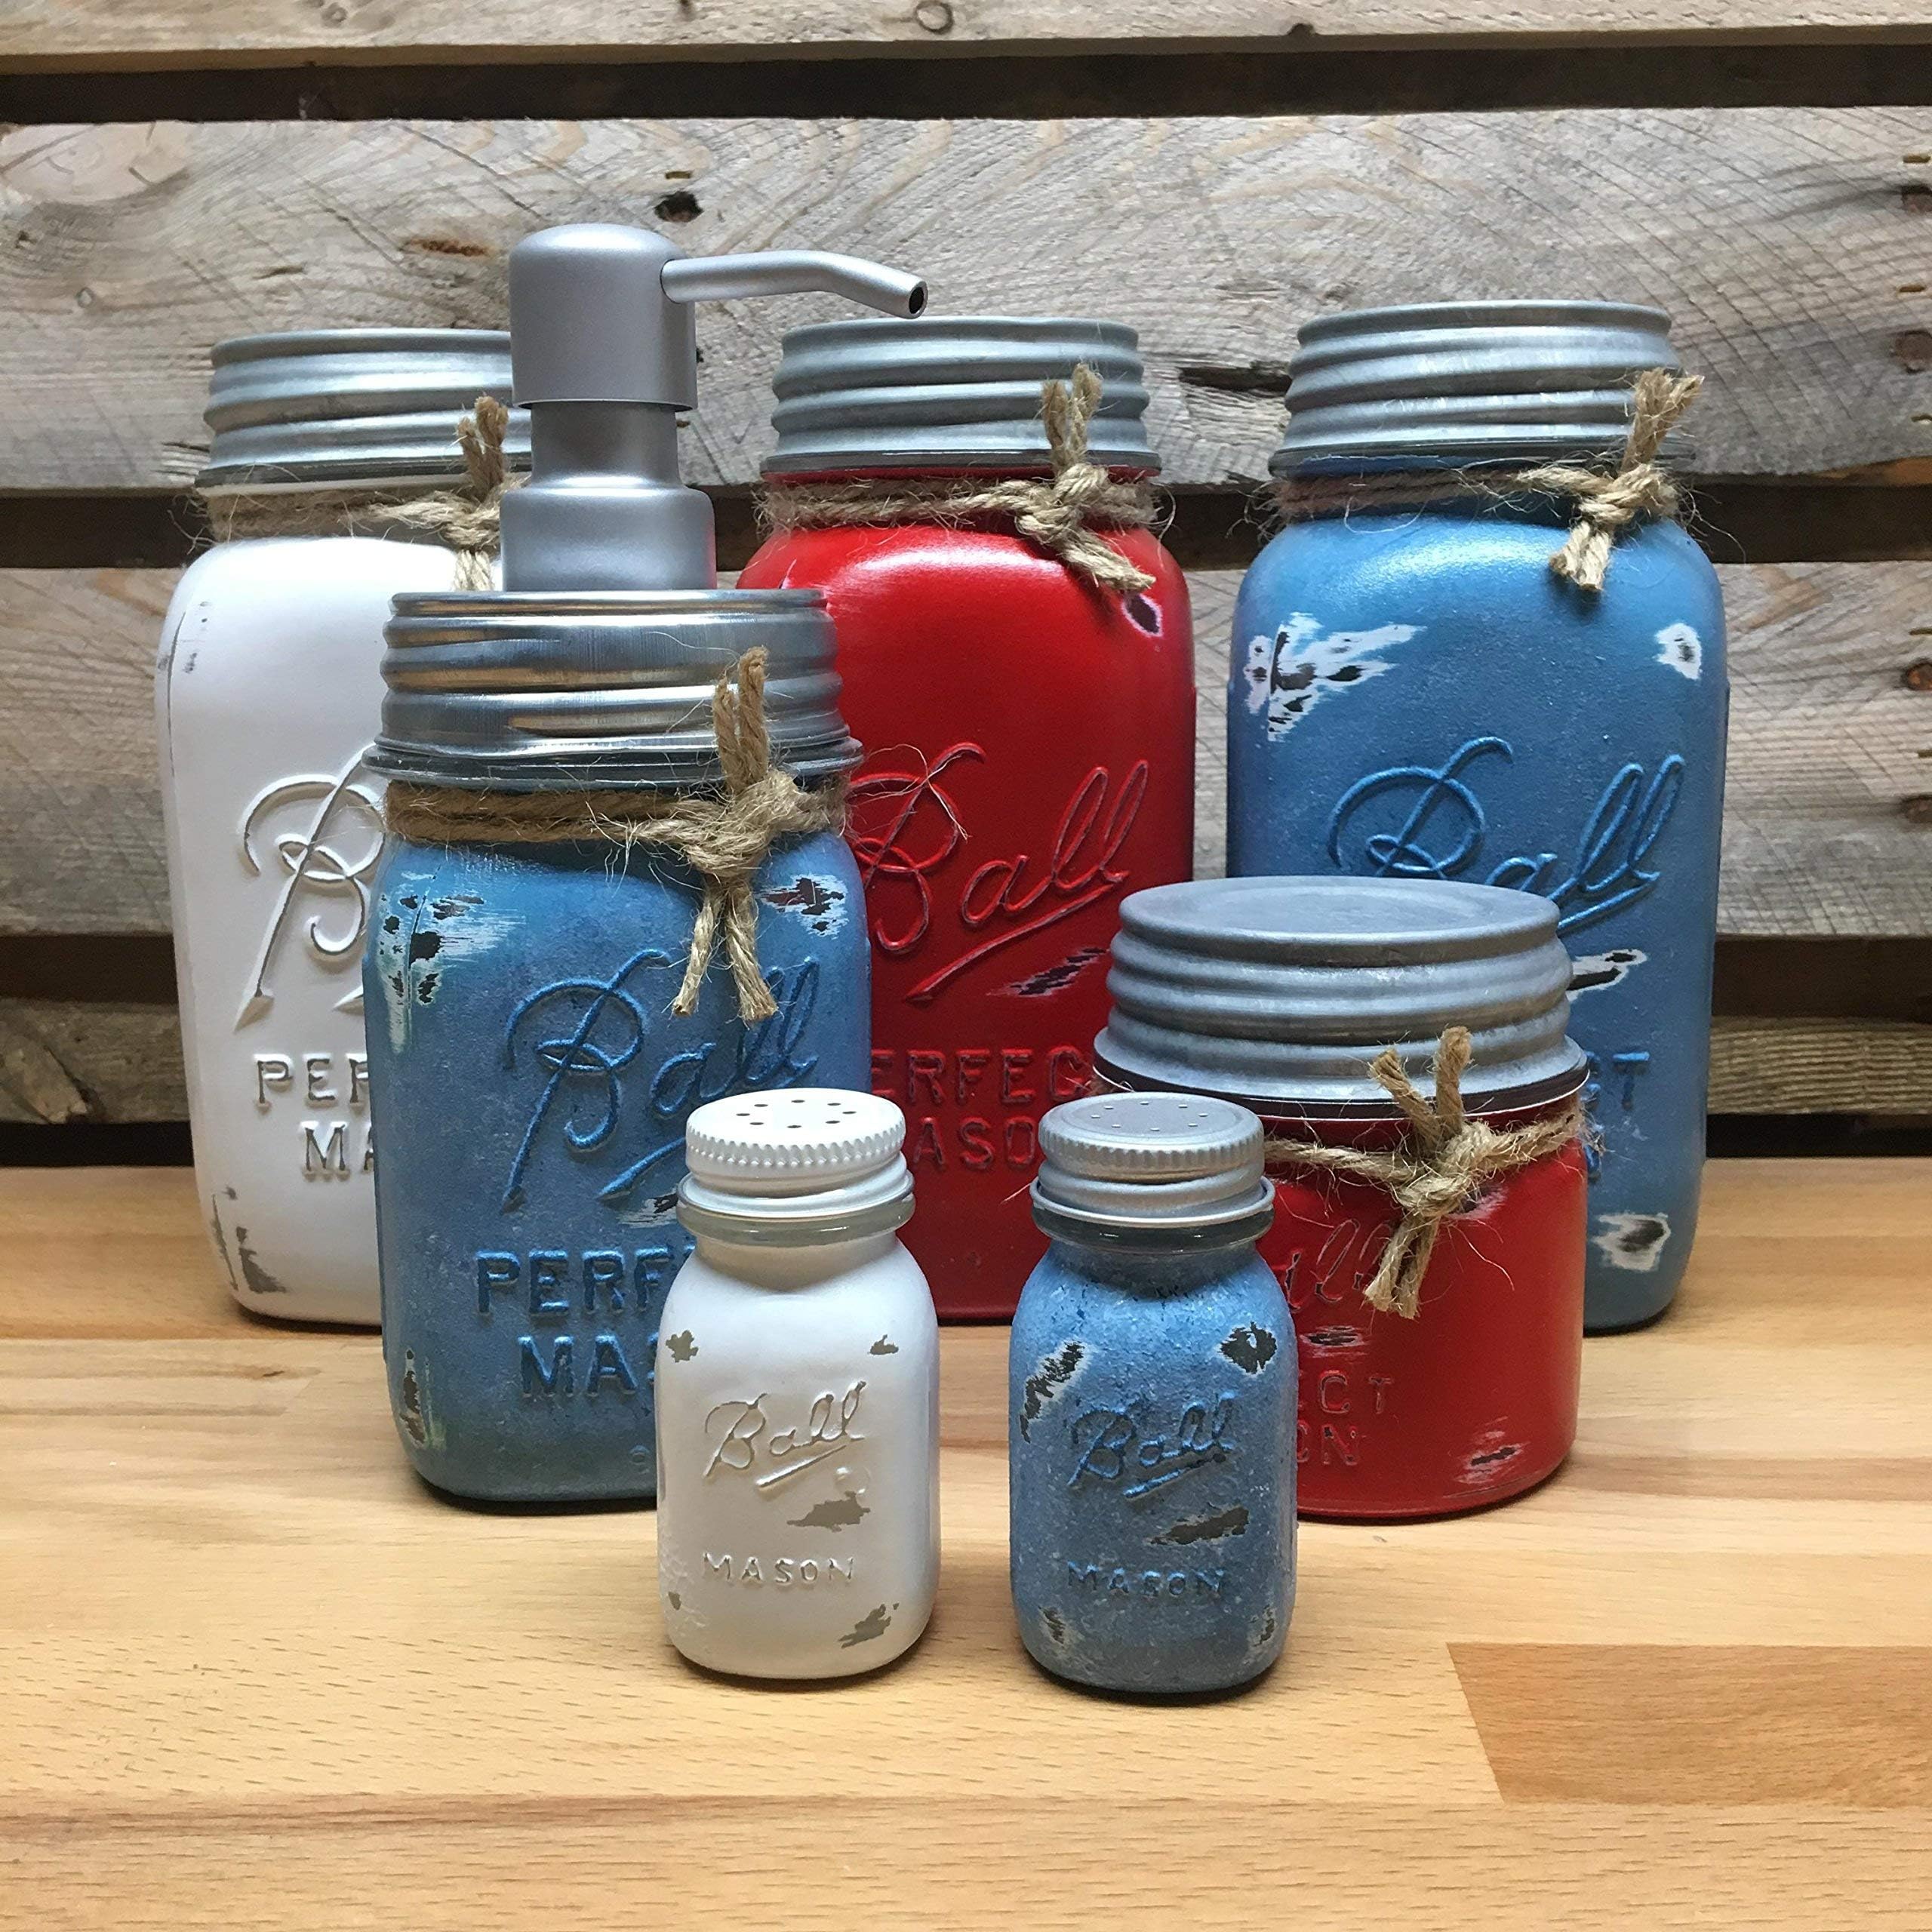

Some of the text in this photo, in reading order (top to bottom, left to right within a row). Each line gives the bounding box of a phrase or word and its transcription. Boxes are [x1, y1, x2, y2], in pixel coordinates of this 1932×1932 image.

[849, 743, 1149, 952] Ball
[501, 948, 820, 1211] Ball
[872, 1044, 1087, 1102] ERFEC
[912, 1116, 1035, 1167] ASO
[475, 1246, 696, 1316] PERF
[702, 1380, 868, 1480] Ball
[1066, 1390, 1241, 1487] Ball
[701, 1551, 855, 1586] MASON
[1066, 1560, 1226, 1598] MASON
